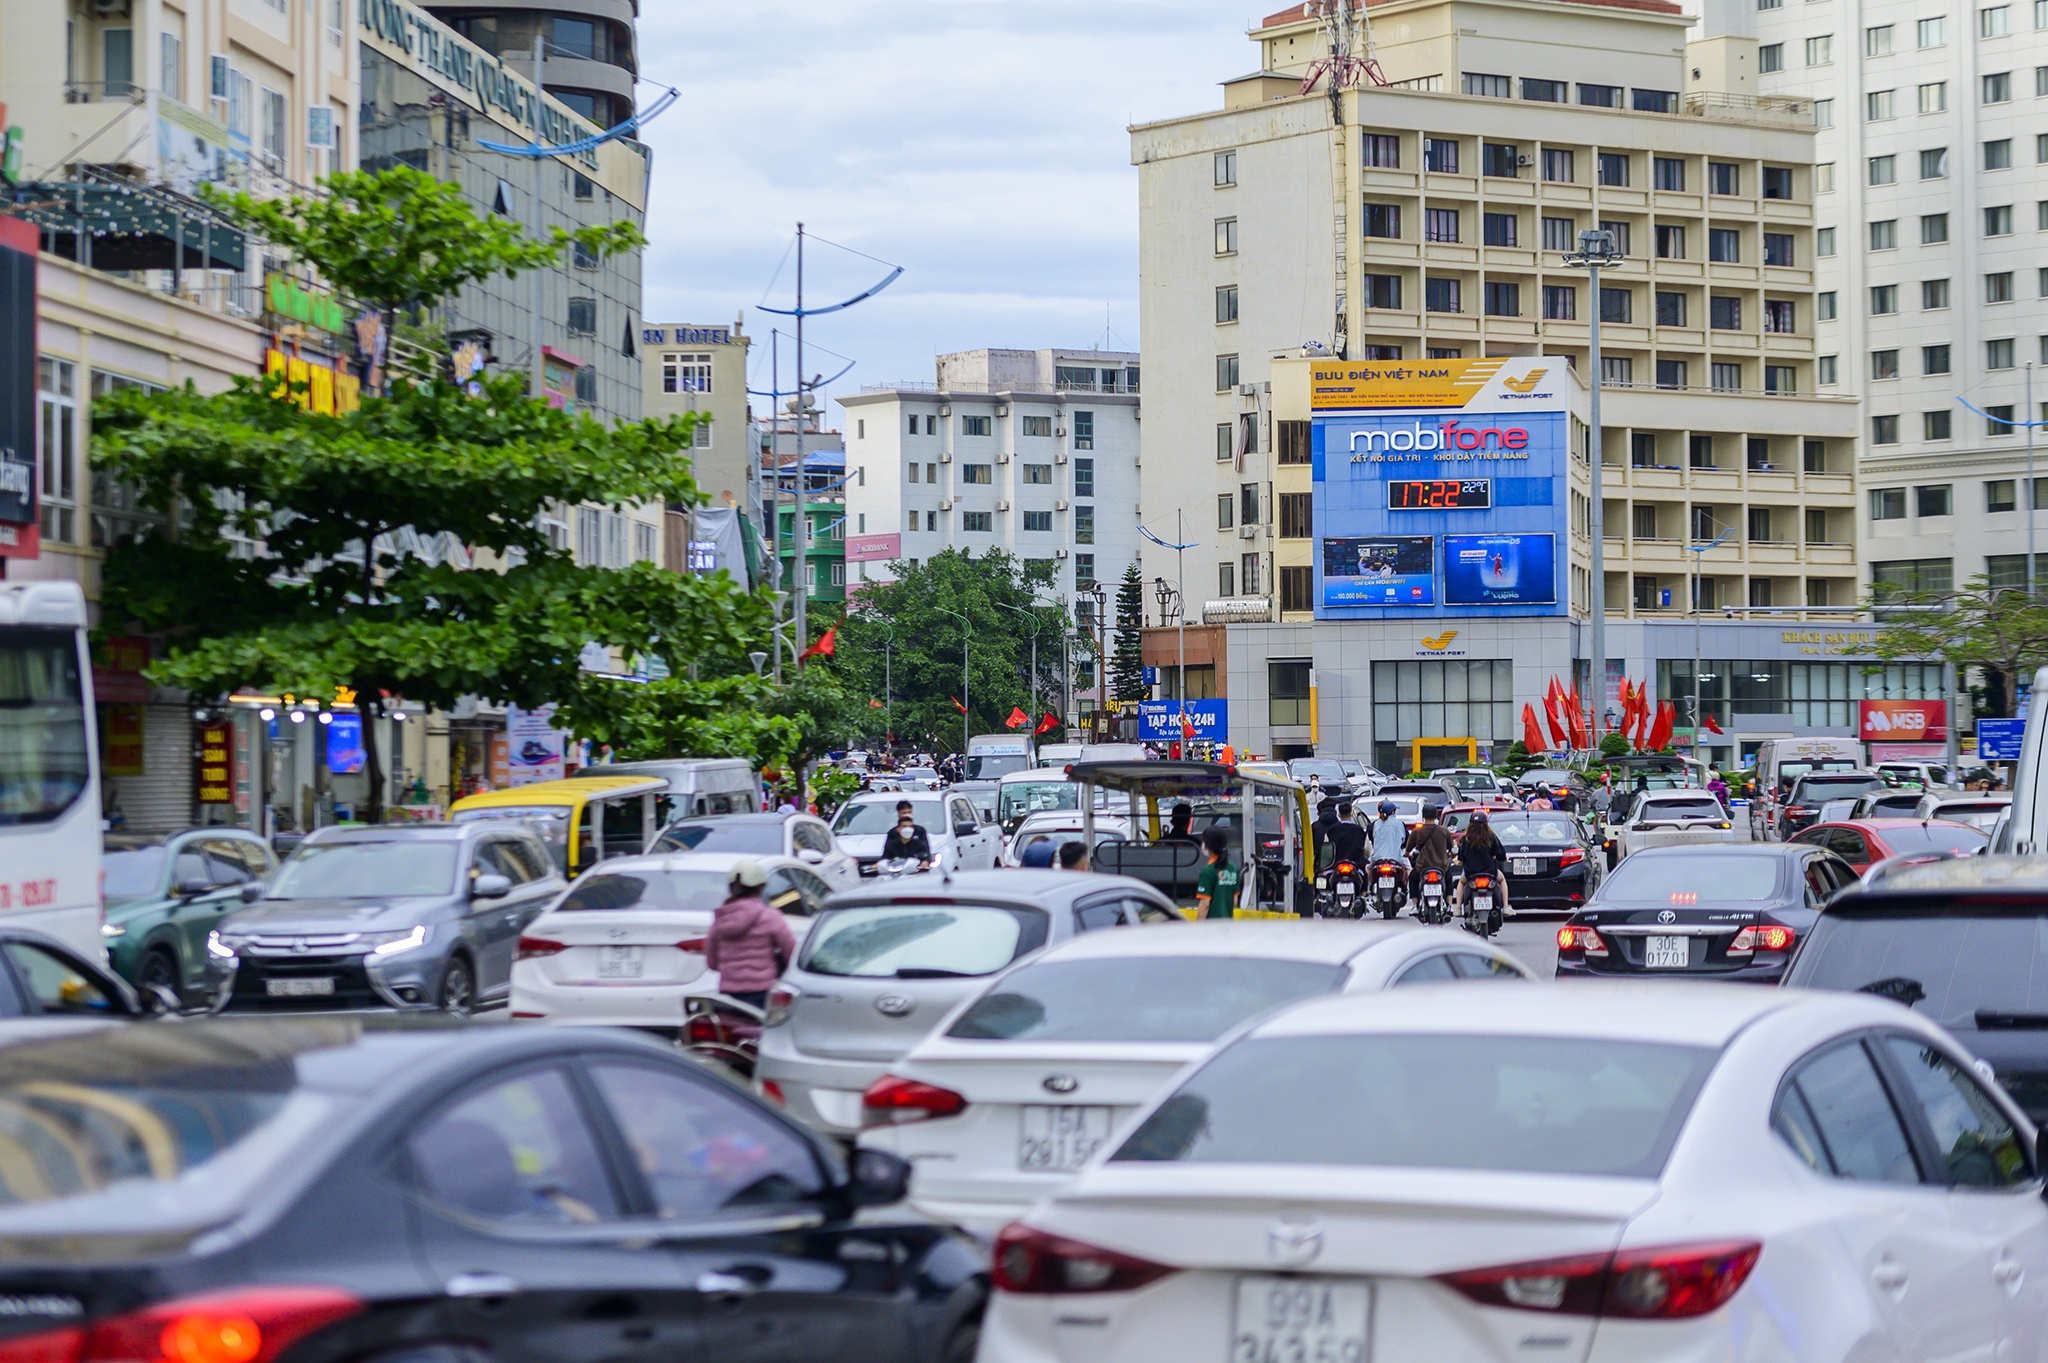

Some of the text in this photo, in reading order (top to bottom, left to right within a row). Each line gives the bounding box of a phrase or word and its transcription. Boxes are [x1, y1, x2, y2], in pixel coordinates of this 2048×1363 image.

[675, 327, 730, 344] HOTEL
[1384, 368, 1413, 380] VIỆT
[1418, 369, 1449, 378] NAM
[1350, 420, 1528, 451] mobifone
[1350, 453, 1367, 463] KẾT
[1388, 453, 1404, 462] GIÁ
[1405, 454, 1421, 463] TRỊ
[1402, 481, 1461, 507] 17:22
[861, 544, 888, 552] AGRIBANK
[1783, 628, 1821, 643] KHÁCH
[1825, 633, 1845, 646] SẠN
[1147, 715, 1167, 730] TẠP
[1194, 713, 1215, 726] 24H
[1892, 713, 1925, 730] MSB
[1656, 938, 1678, 950] 30E
[1647, 951, 1686, 965] 017.01
[1268, 1286, 1334, 1328] 99A
